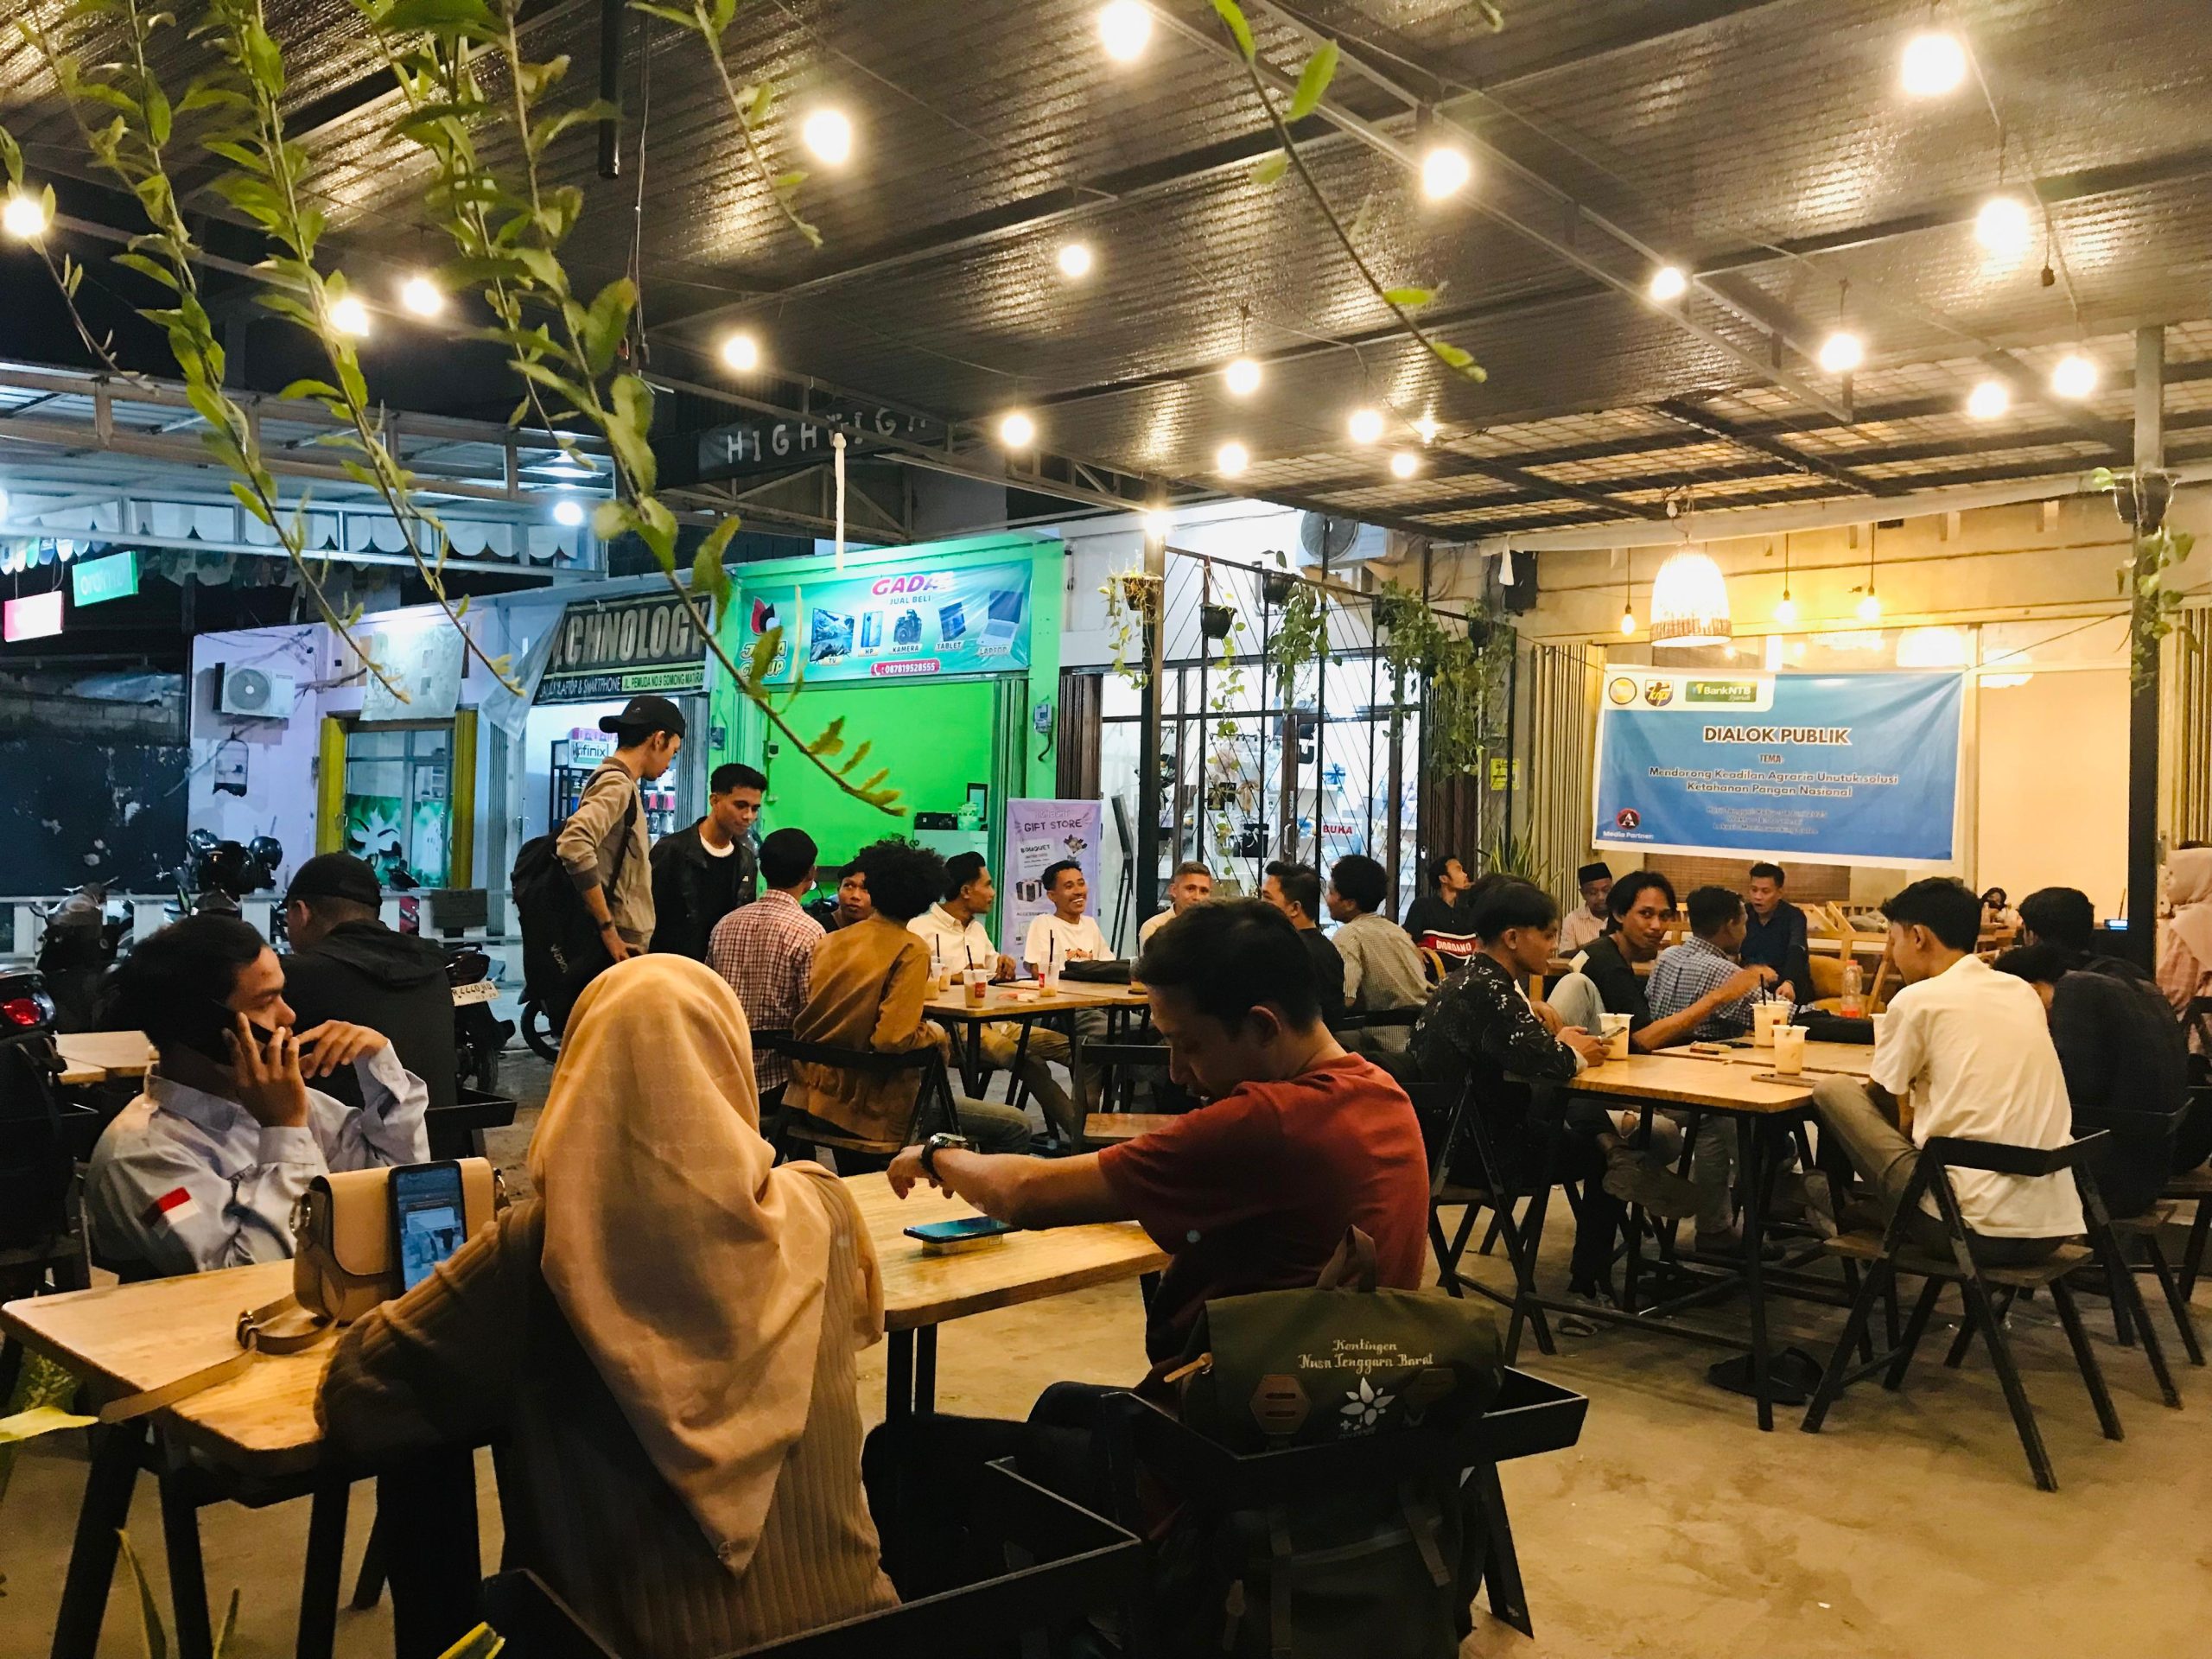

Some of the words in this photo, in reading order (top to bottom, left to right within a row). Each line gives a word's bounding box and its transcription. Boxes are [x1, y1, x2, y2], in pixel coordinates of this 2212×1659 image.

[912, 594, 931, 603] BELI
[892, 645, 919, 653] KAMERA
[937, 641, 962, 650] TABLET
[1704, 727, 1776, 742] DIALOK
[1781, 728, 1851, 744] PUBLIK
[1649, 767, 1712, 780] Mendorong
[1715, 769, 1764, 779] Keadilan
[1768, 771, 1814, 782] Agraria
[1817, 772, 1859, 783] Unutuk
[1687, 782, 1749, 793] Ketahanan
[1752, 784, 1797, 796] Pangan
[1799, 785, 1853, 797] Nasional
[1024, 822, 1046, 832] GIFT
[1050, 819, 1083, 830] STORE
[1323, 825, 1352, 835] BUKA
[1020, 844, 1051, 854] BOUQUET
[1436, 940, 1471, 952] GIORDANO
[1332, 1339, 1397, 1354] Kontingen
[1298, 1354, 1332, 1369] Nusa
[1334, 1353, 1393, 1374] Tenggara
[1397, 1353, 1433, 1367] Barat
